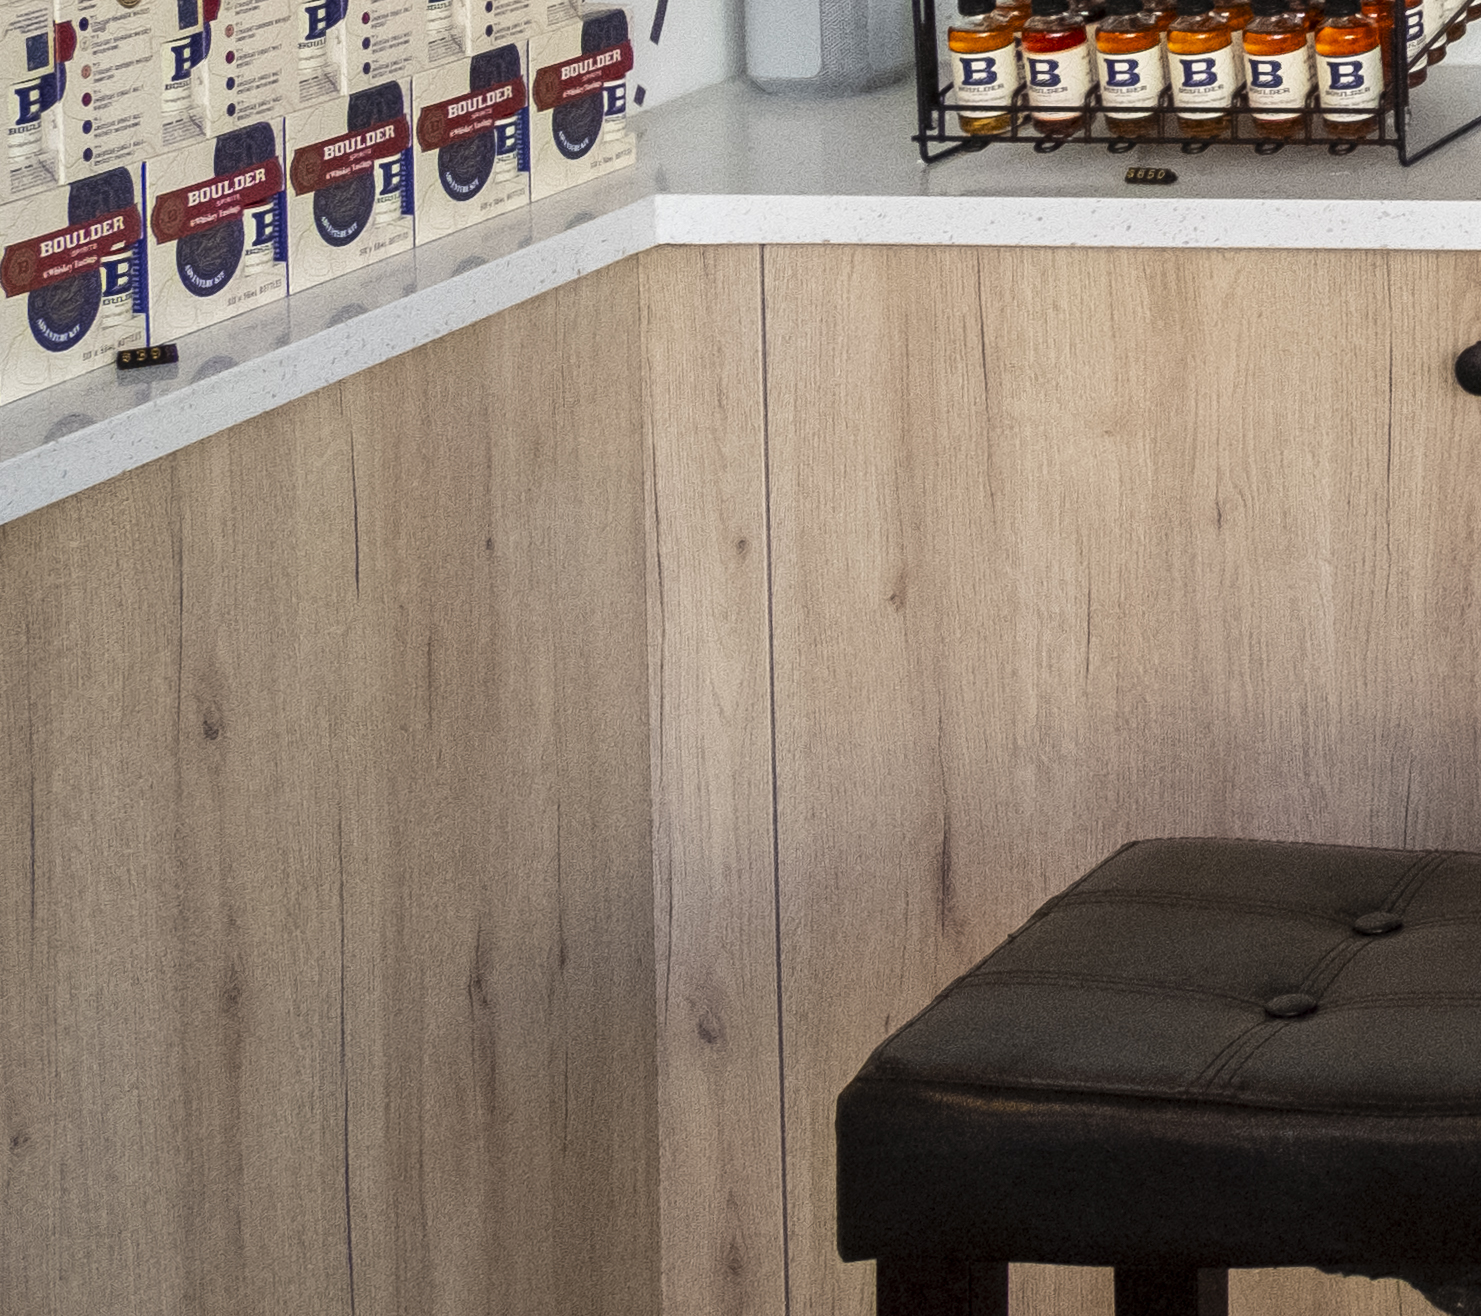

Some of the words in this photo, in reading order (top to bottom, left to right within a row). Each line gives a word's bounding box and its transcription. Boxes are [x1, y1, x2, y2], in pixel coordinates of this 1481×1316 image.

[960, 56, 998, 87] B
[1027, 57, 1062, 88] B
[1103, 58, 1140, 88] B
[1180, 57, 1218, 88] B
[1248, 58, 1283, 89] B
[1327, 60, 1365, 90] B
[323, 125, 395, 161] BOULDER
[187, 167, 266, 207] BOULDER
